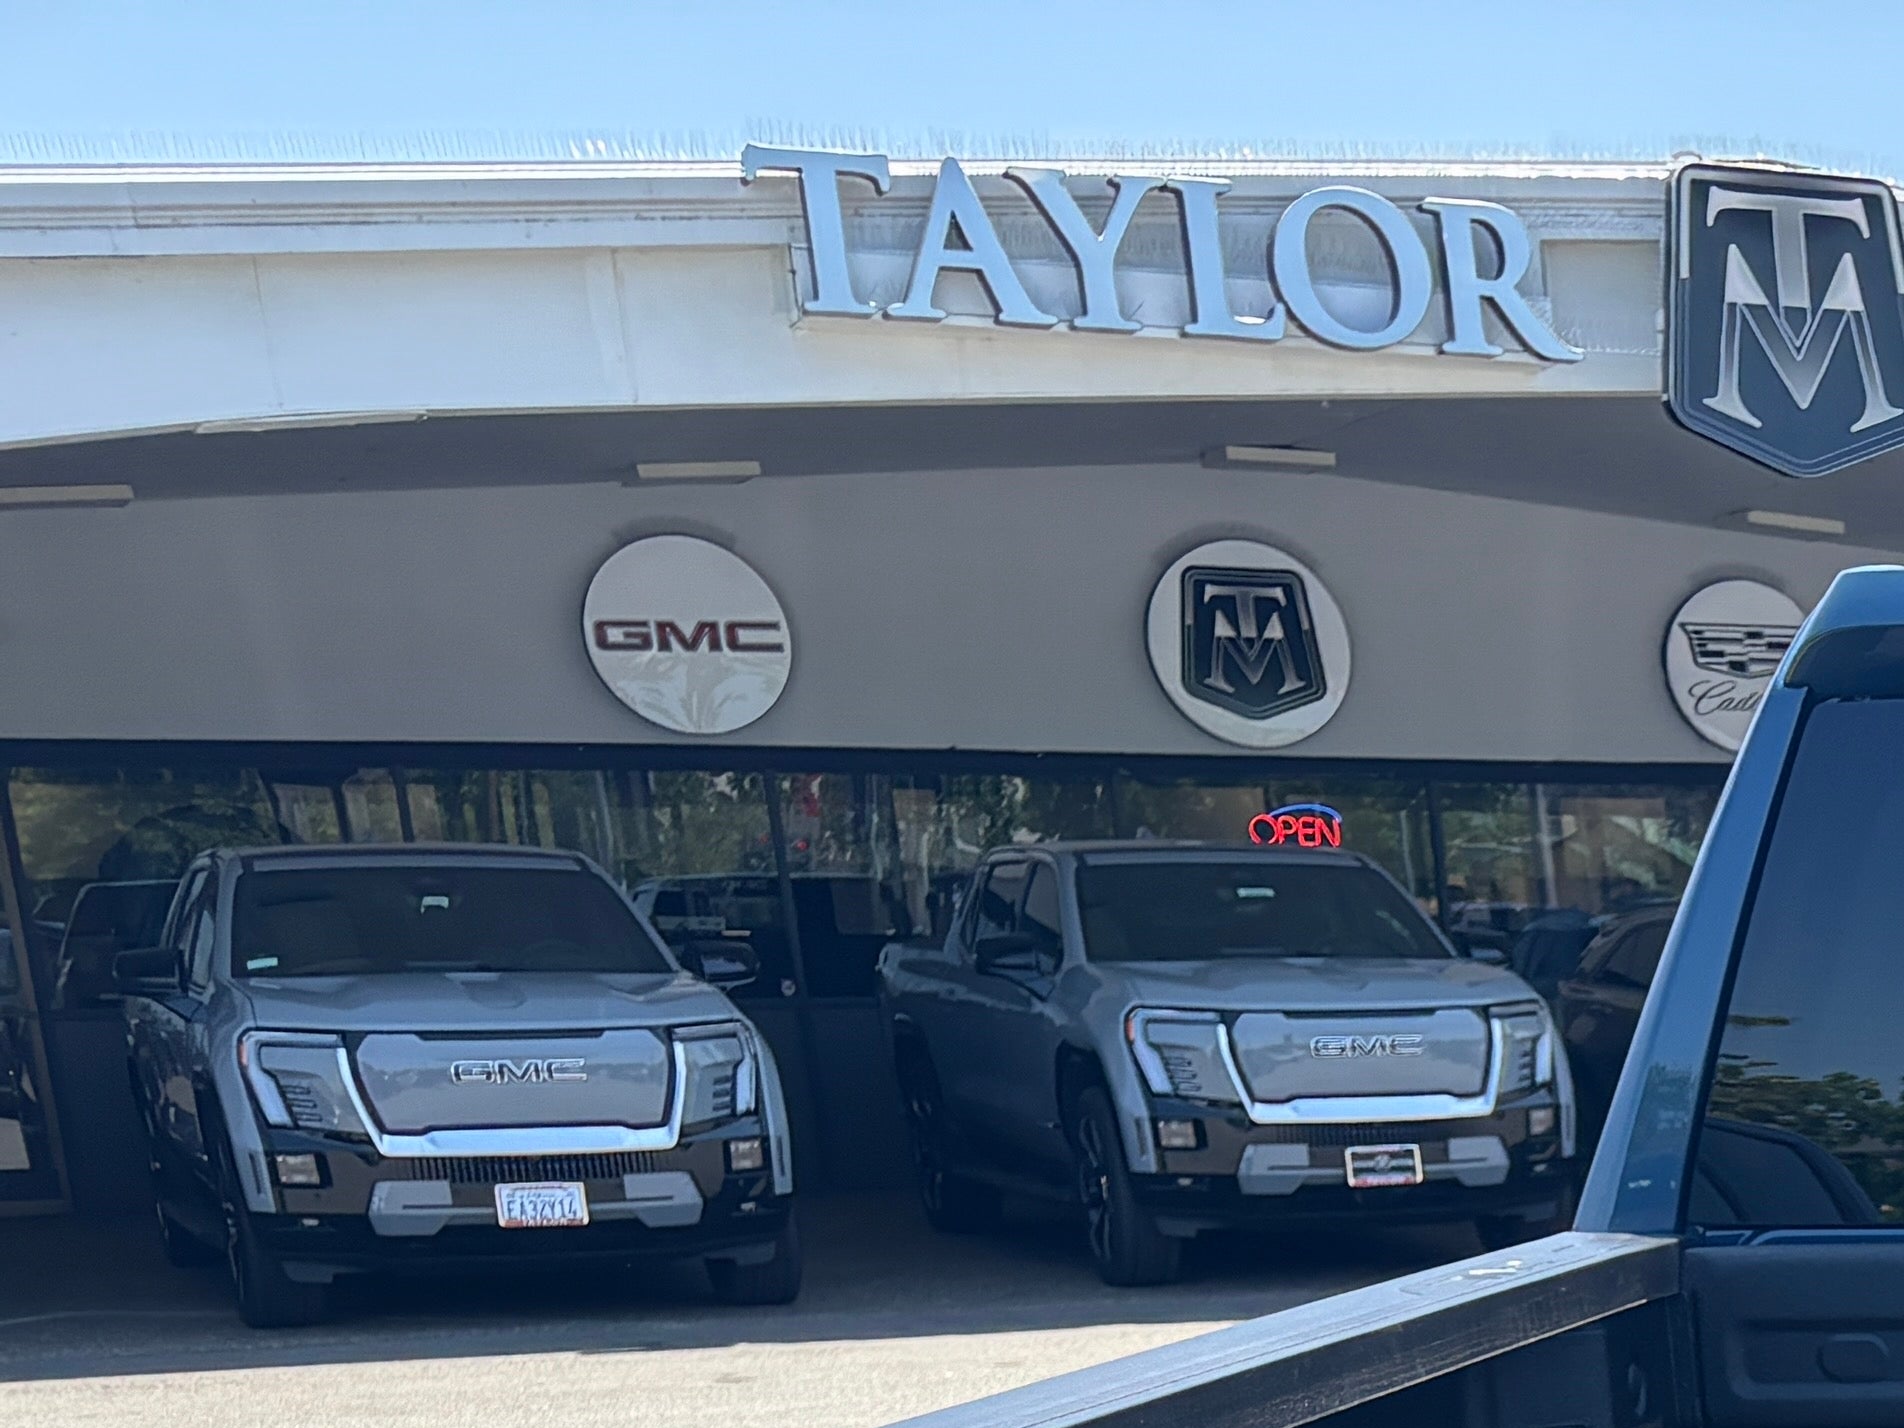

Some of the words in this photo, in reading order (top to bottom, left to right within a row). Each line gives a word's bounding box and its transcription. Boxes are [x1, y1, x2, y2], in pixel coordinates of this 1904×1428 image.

[741, 142, 1585, 363] TAYLOR
[593, 620, 785, 653] GMC
[1249, 812, 1341, 847] OPEN
[1310, 1034, 1425, 1059] GMC
[451, 1058, 587, 1084] GMC
